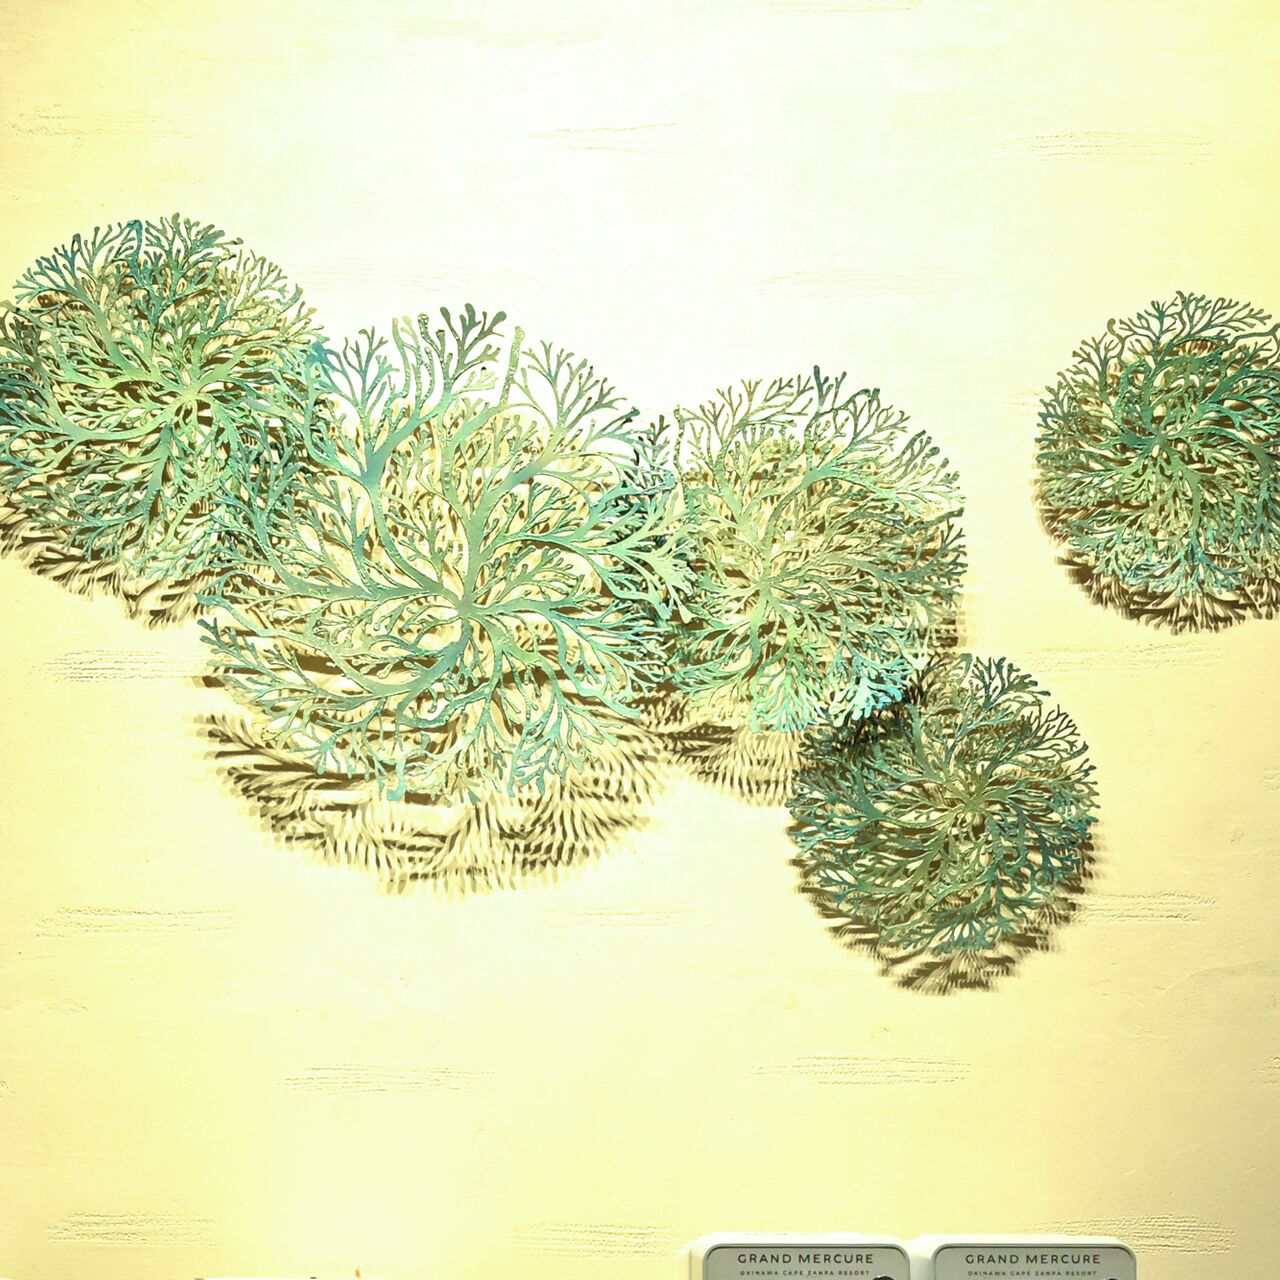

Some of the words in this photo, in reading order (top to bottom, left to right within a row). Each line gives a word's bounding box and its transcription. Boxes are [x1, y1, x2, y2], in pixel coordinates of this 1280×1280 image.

[737, 1253, 792, 1264] GRAND
[799, 1253, 873, 1264] MERCURE
[965, 1254, 1019, 1264] GRAND
[1025, 1254, 1101, 1264] MERCURE
